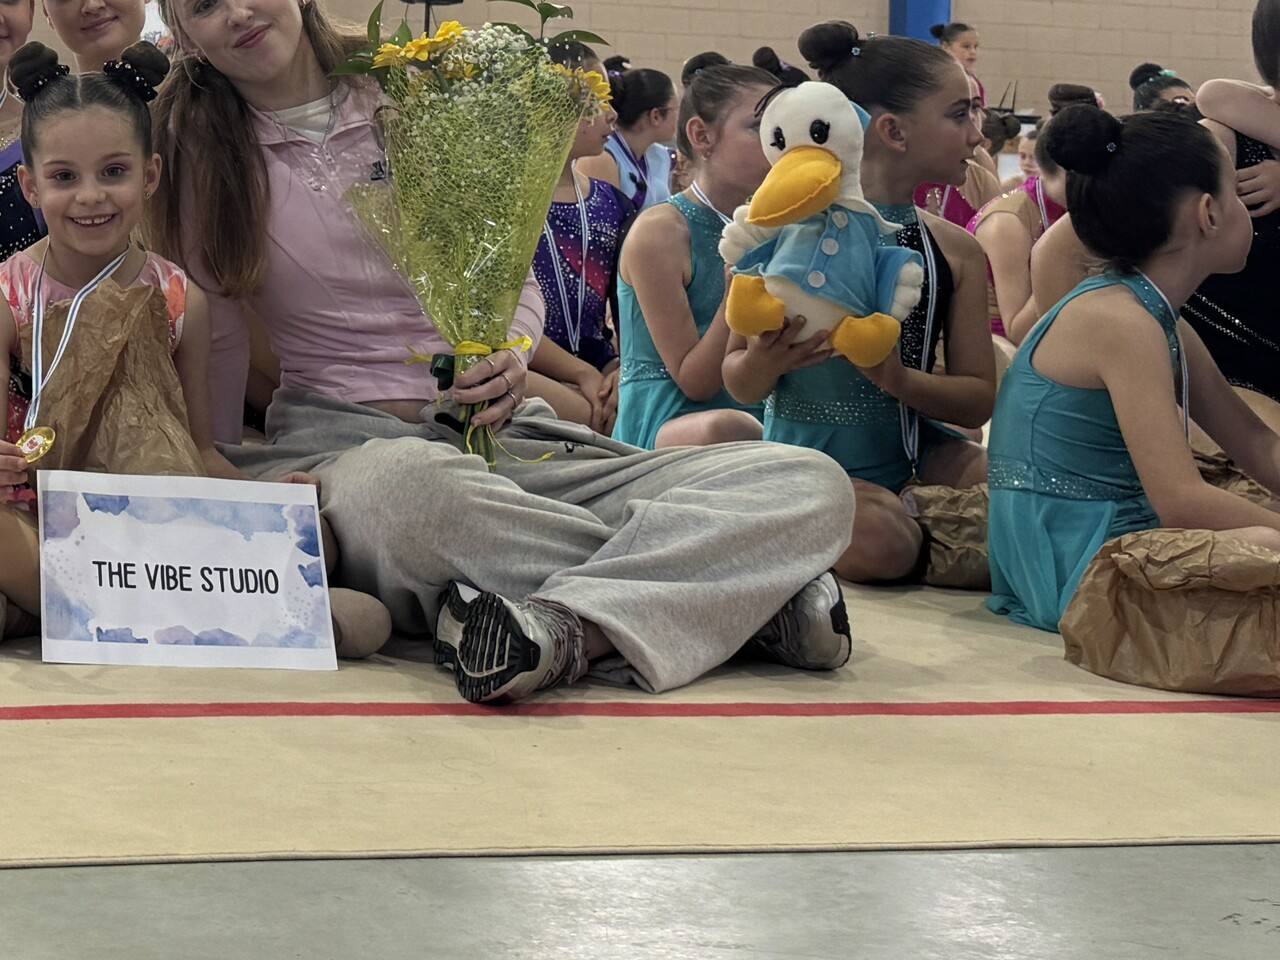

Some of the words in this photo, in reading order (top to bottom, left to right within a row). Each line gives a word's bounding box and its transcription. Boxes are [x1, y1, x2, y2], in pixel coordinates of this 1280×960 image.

[91, 560, 137, 589] THE
[144, 563, 193, 592] VIBE
[199, 566, 279, 595] STUDIO
